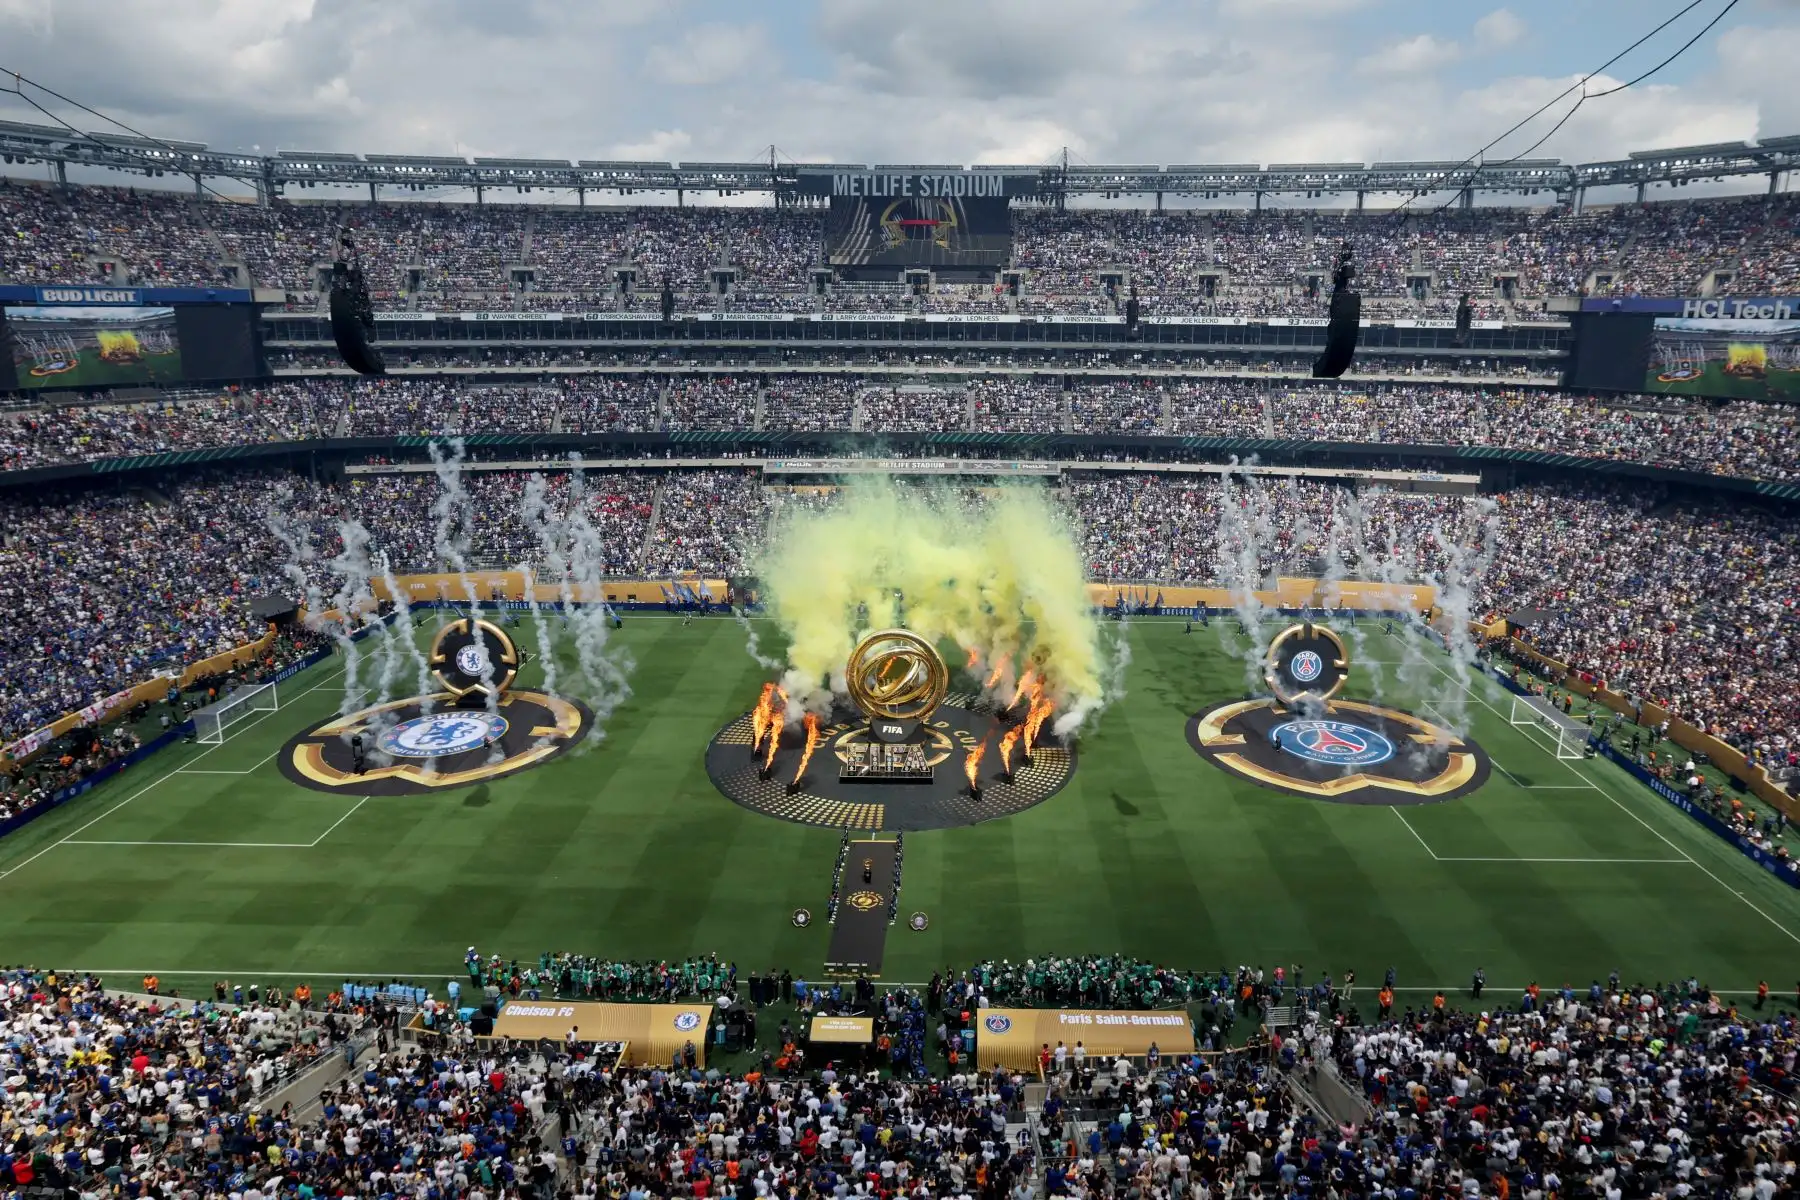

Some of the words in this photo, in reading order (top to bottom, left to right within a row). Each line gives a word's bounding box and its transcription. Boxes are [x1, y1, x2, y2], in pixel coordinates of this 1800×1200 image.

[833, 175, 912, 197] METLIFE
[919, 175, 1003, 197] STADIUM
[42, 289, 82, 302] BUD
[84, 290, 136, 302] LIGHT
[1683, 300, 1791, 319] HCLTech
[1297, 652, 1316, 660] PARIS
[422, 712, 496, 723] CHELSE
[882, 725, 903, 734] FIFA
[1284, 722, 1356, 732] PARIS
[438, 745, 469, 754] CLUB
[846, 742, 930, 772] FIFA
[1650, 778, 1680, 804] CHELSEA
[1682, 800, 1692, 812] FC
[505, 1006, 556, 1016] Chelsea
[558, 1006, 574, 1016] FC
[1060, 1014, 1092, 1024] Paris
[1096, 1014, 1184, 1026] Saint-Germain
